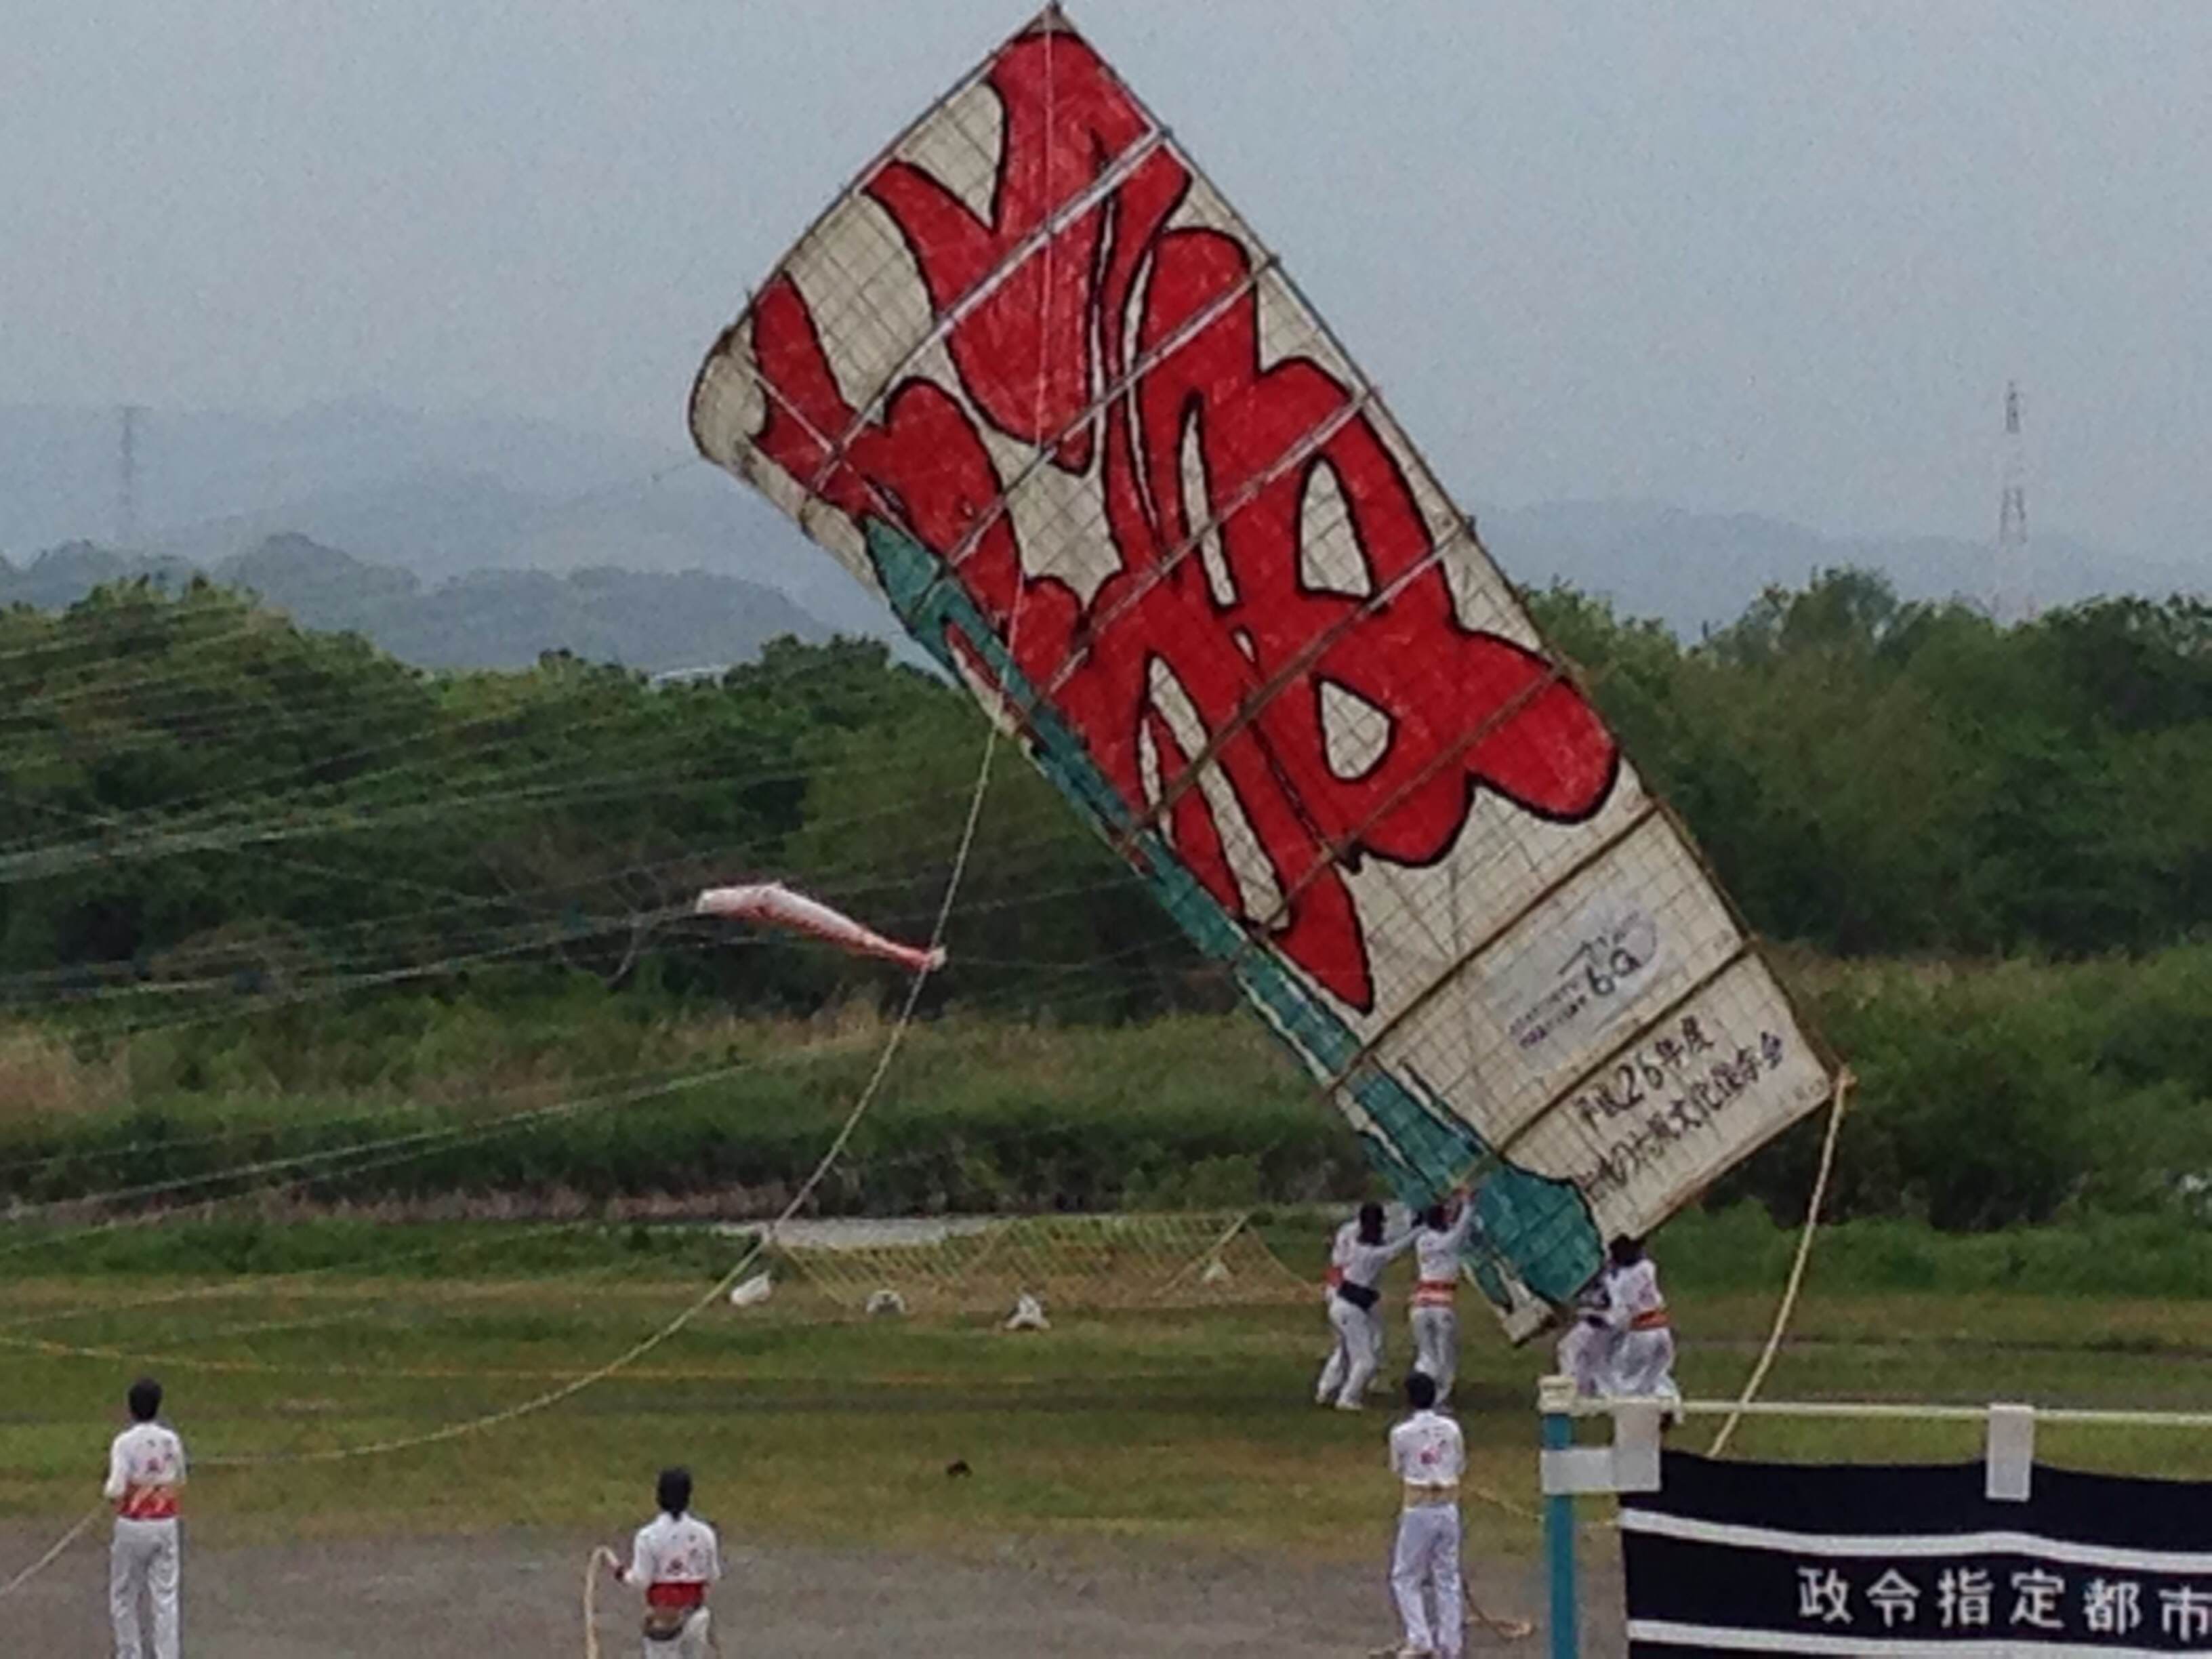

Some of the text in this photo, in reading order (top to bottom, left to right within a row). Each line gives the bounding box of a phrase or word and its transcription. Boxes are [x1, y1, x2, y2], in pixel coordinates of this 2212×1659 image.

[1797, 1567, 2212, 1641] 政令指定都市
